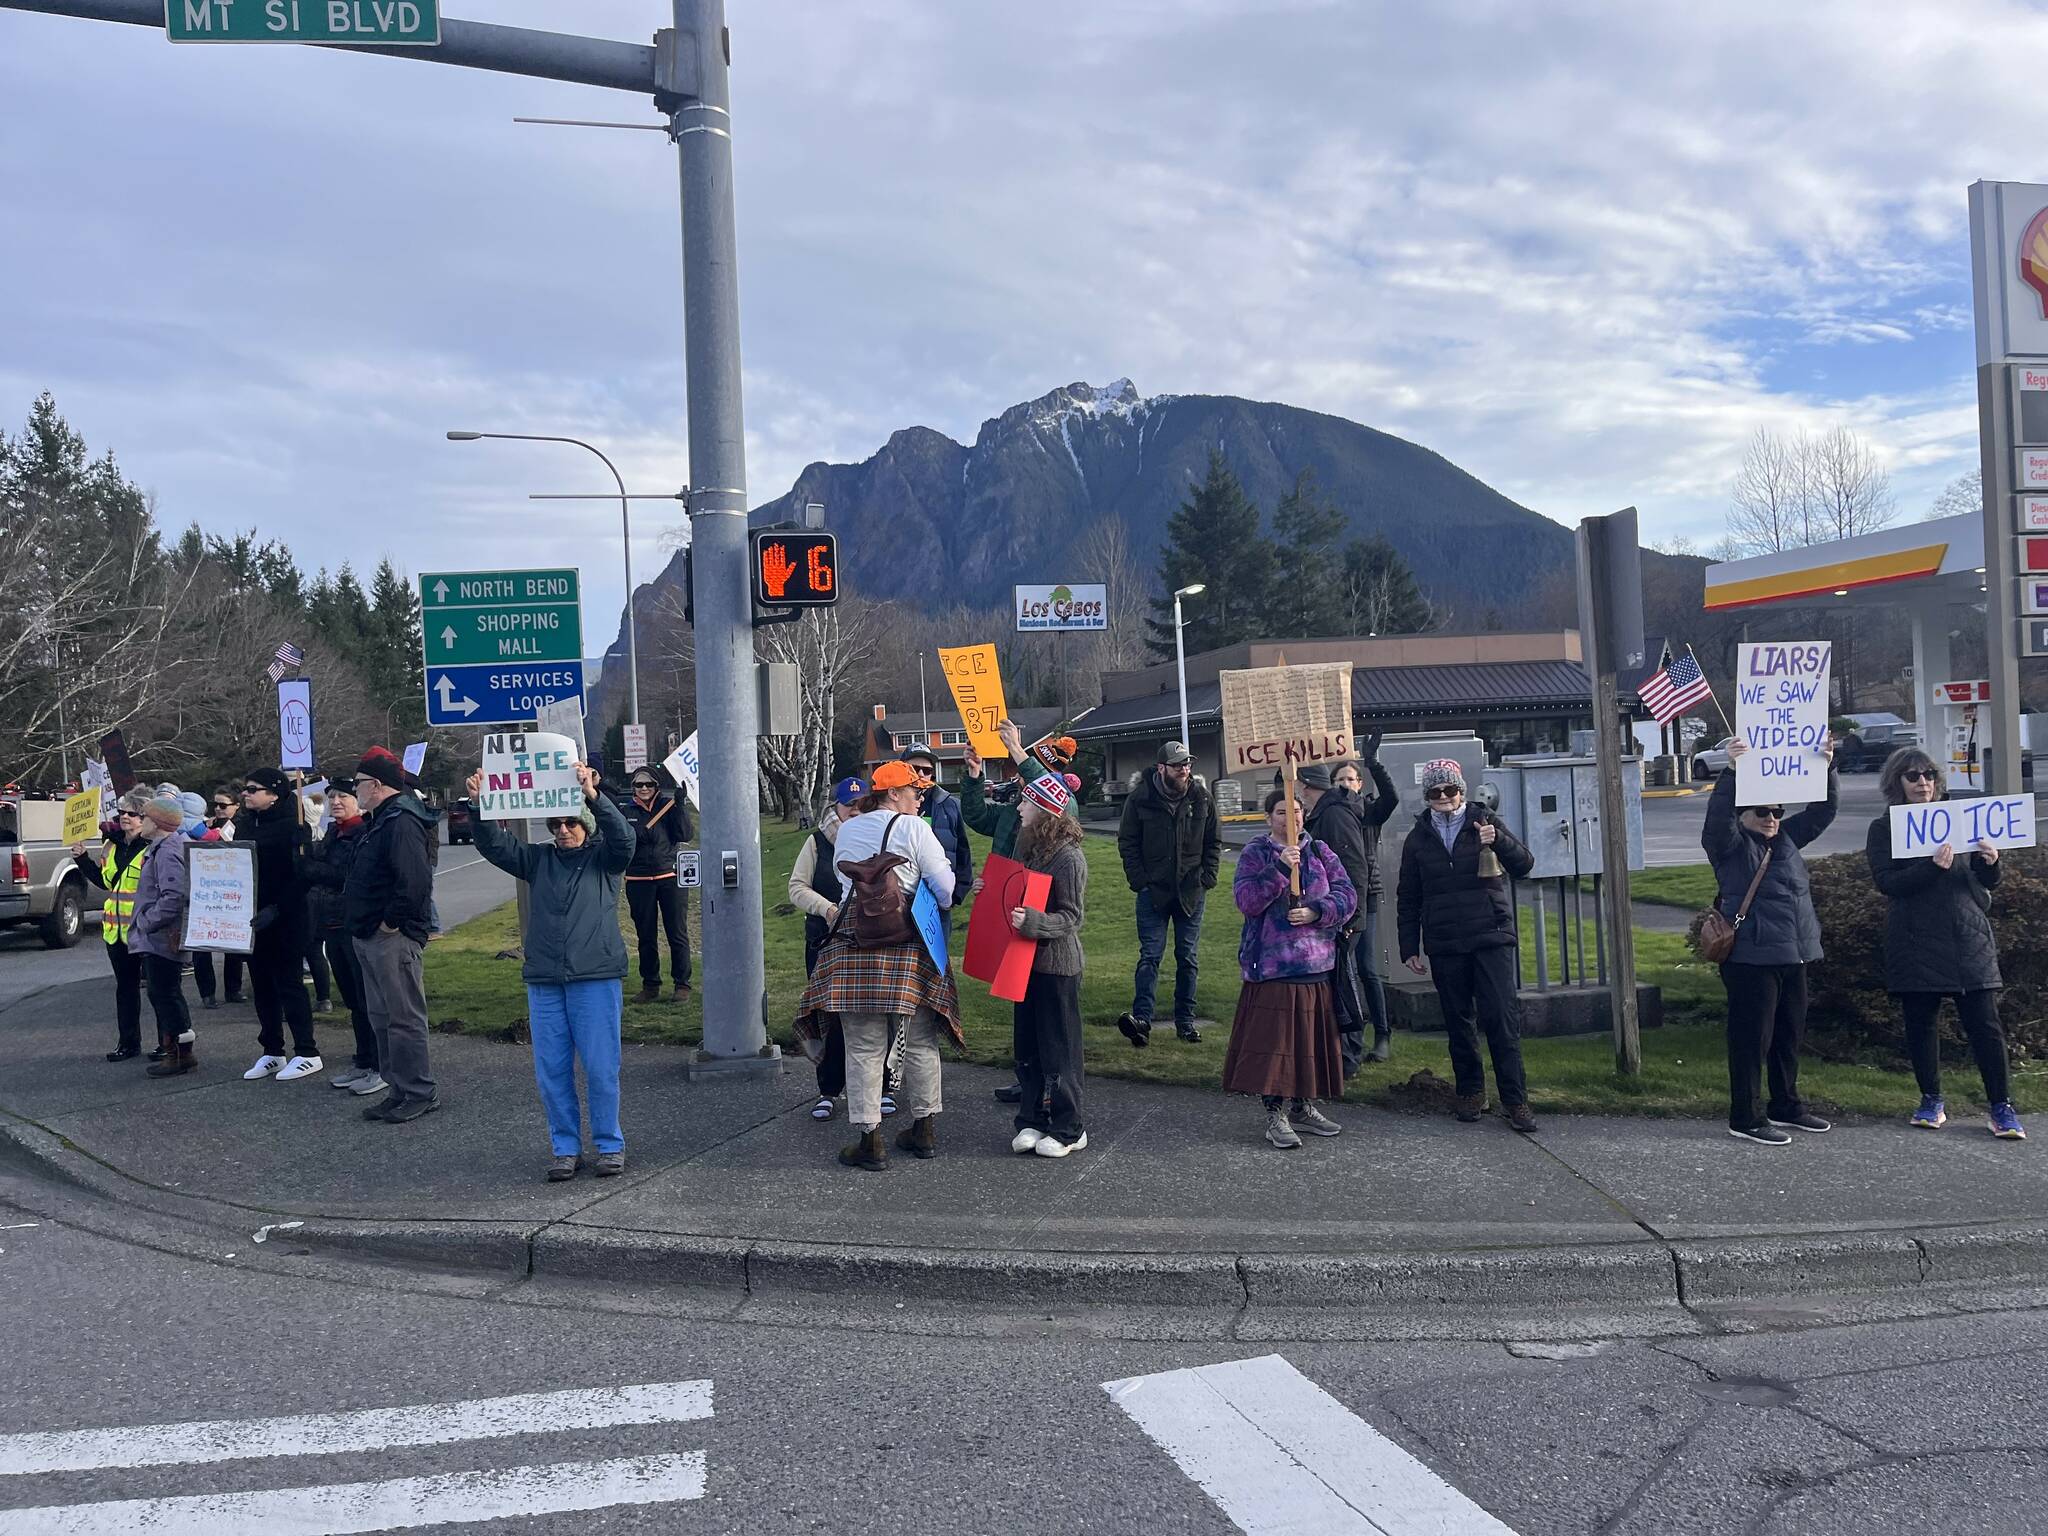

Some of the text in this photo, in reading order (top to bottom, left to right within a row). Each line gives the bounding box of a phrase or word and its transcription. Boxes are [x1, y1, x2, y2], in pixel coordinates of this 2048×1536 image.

[185, 0, 420, 33] MT SI BLVD
[2026, 371, 2048, 389] Reg
[460, 578, 569, 599] NORTH BEND
[477, 612, 559, 632] SHOPPING
[498, 637, 542, 656] MALL
[941, 653, 987, 675] ICE
[1750, 646, 1831, 680] LIARS!
[489, 671, 574, 690] SERVICES
[1740, 680, 1819, 704] WE SAW
[510, 695, 556, 711] LOOP
[287, 716, 304, 735] ICE
[966, 705, 999, 734] 87
[1765, 707, 1796, 725] THE
[487, 734, 527, 755] NO
[1746, 724, 1826, 753] VIDEO!
[1238, 734, 1347, 765] ICE KILLS
[514, 751, 568, 772] ICE
[1761, 755, 1809, 777] DUH.
[488, 772, 533, 792] NO
[480, 786, 582, 811] VIOLENCE
[1906, 800, 2027, 849] NO ICE
[208, 931, 219, 940] NO
